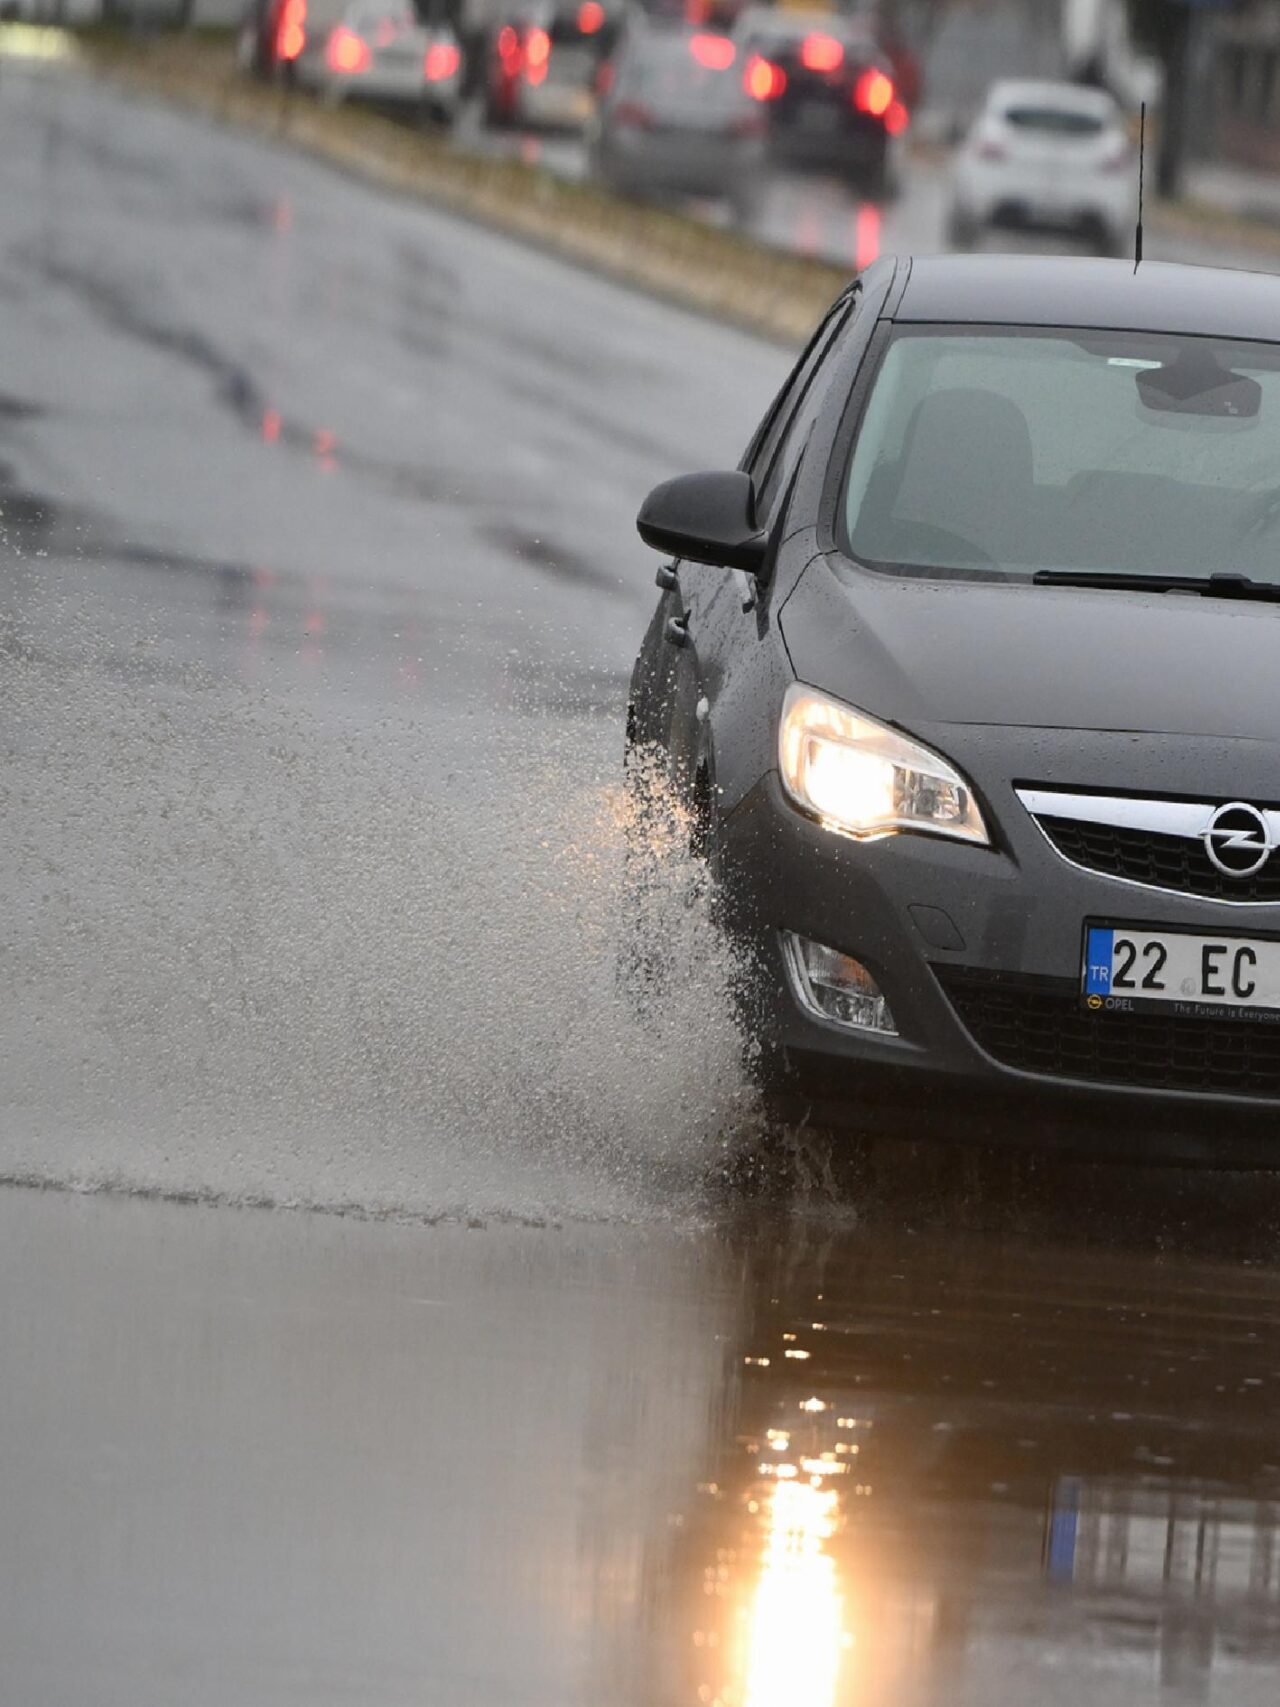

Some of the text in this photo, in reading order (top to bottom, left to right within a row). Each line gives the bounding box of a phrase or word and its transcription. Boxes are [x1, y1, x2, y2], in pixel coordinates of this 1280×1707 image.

[1090, 965, 1109, 981] TR
[1112, 939, 1167, 989] 22
[1201, 944, 1256, 997] EC
[1105, 997, 1134, 1011] OPEL
[1173, 1003, 1190, 1014] The
